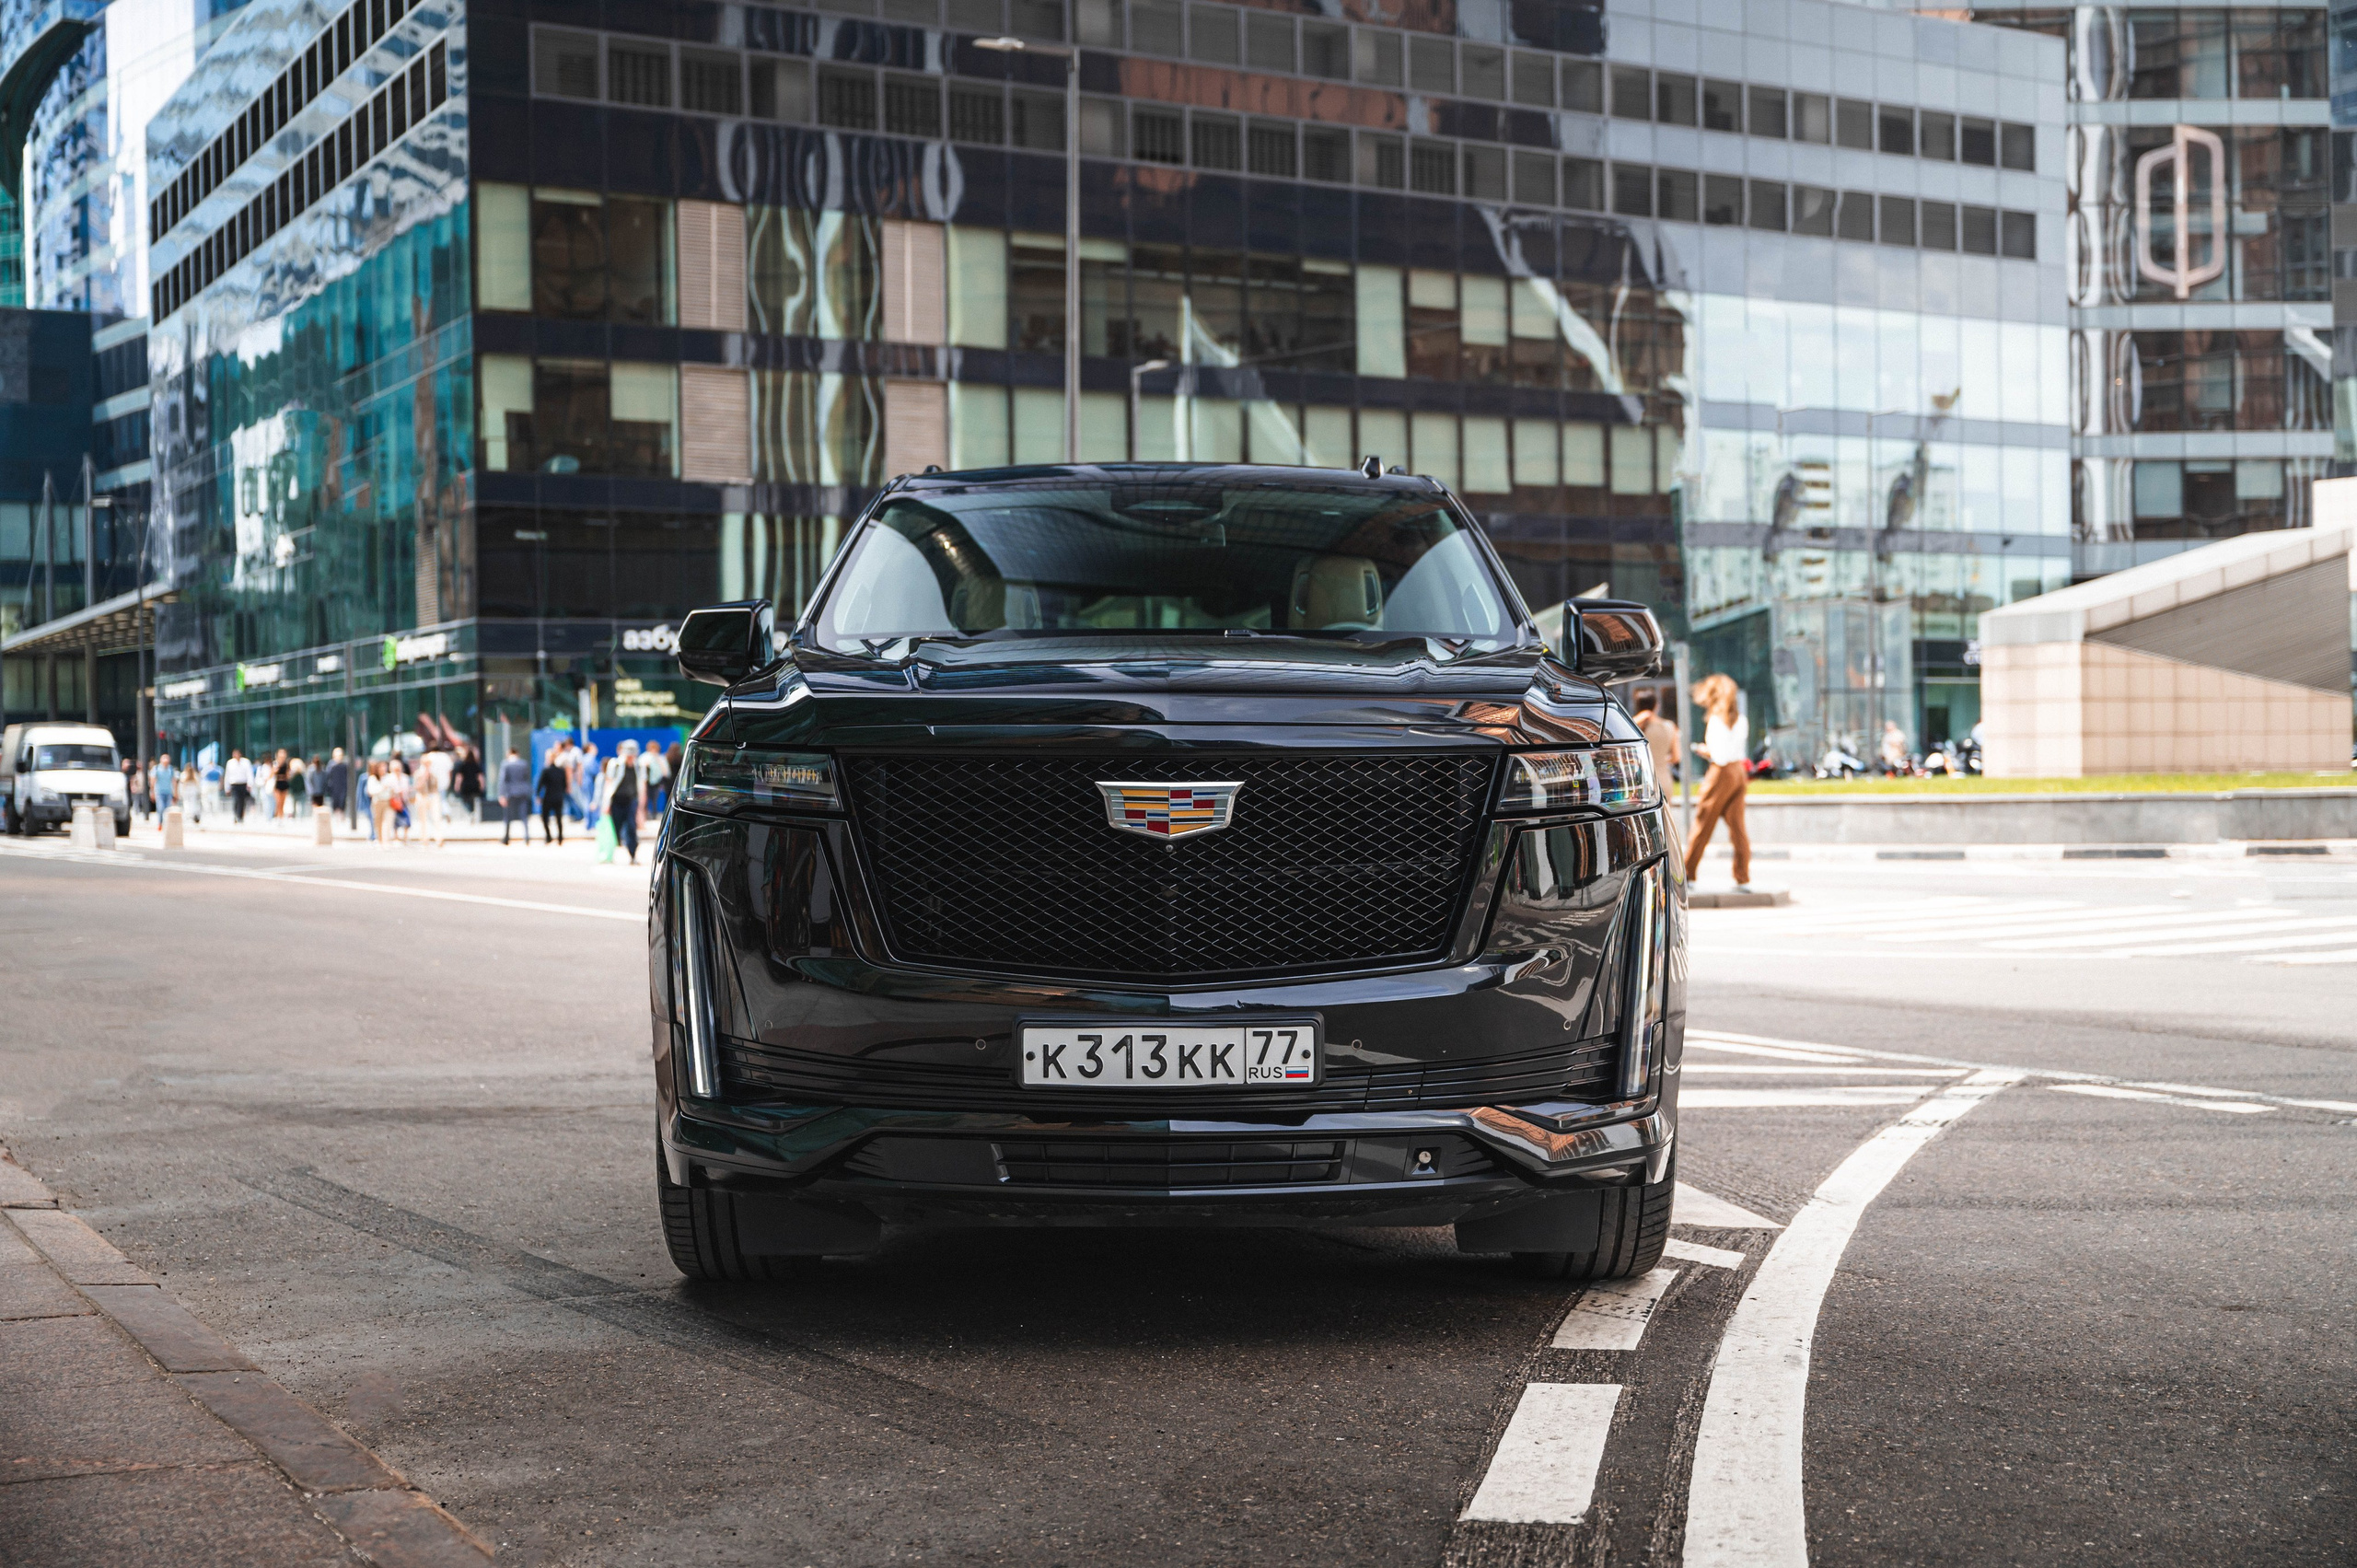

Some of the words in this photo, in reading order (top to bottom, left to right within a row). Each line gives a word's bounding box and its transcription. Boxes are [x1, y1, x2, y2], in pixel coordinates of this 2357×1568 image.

[1042, 1034, 1236, 1079] К313КК
[1252, 1030, 1298, 1065] 77
[1248, 1066, 1283, 1079] RUS
